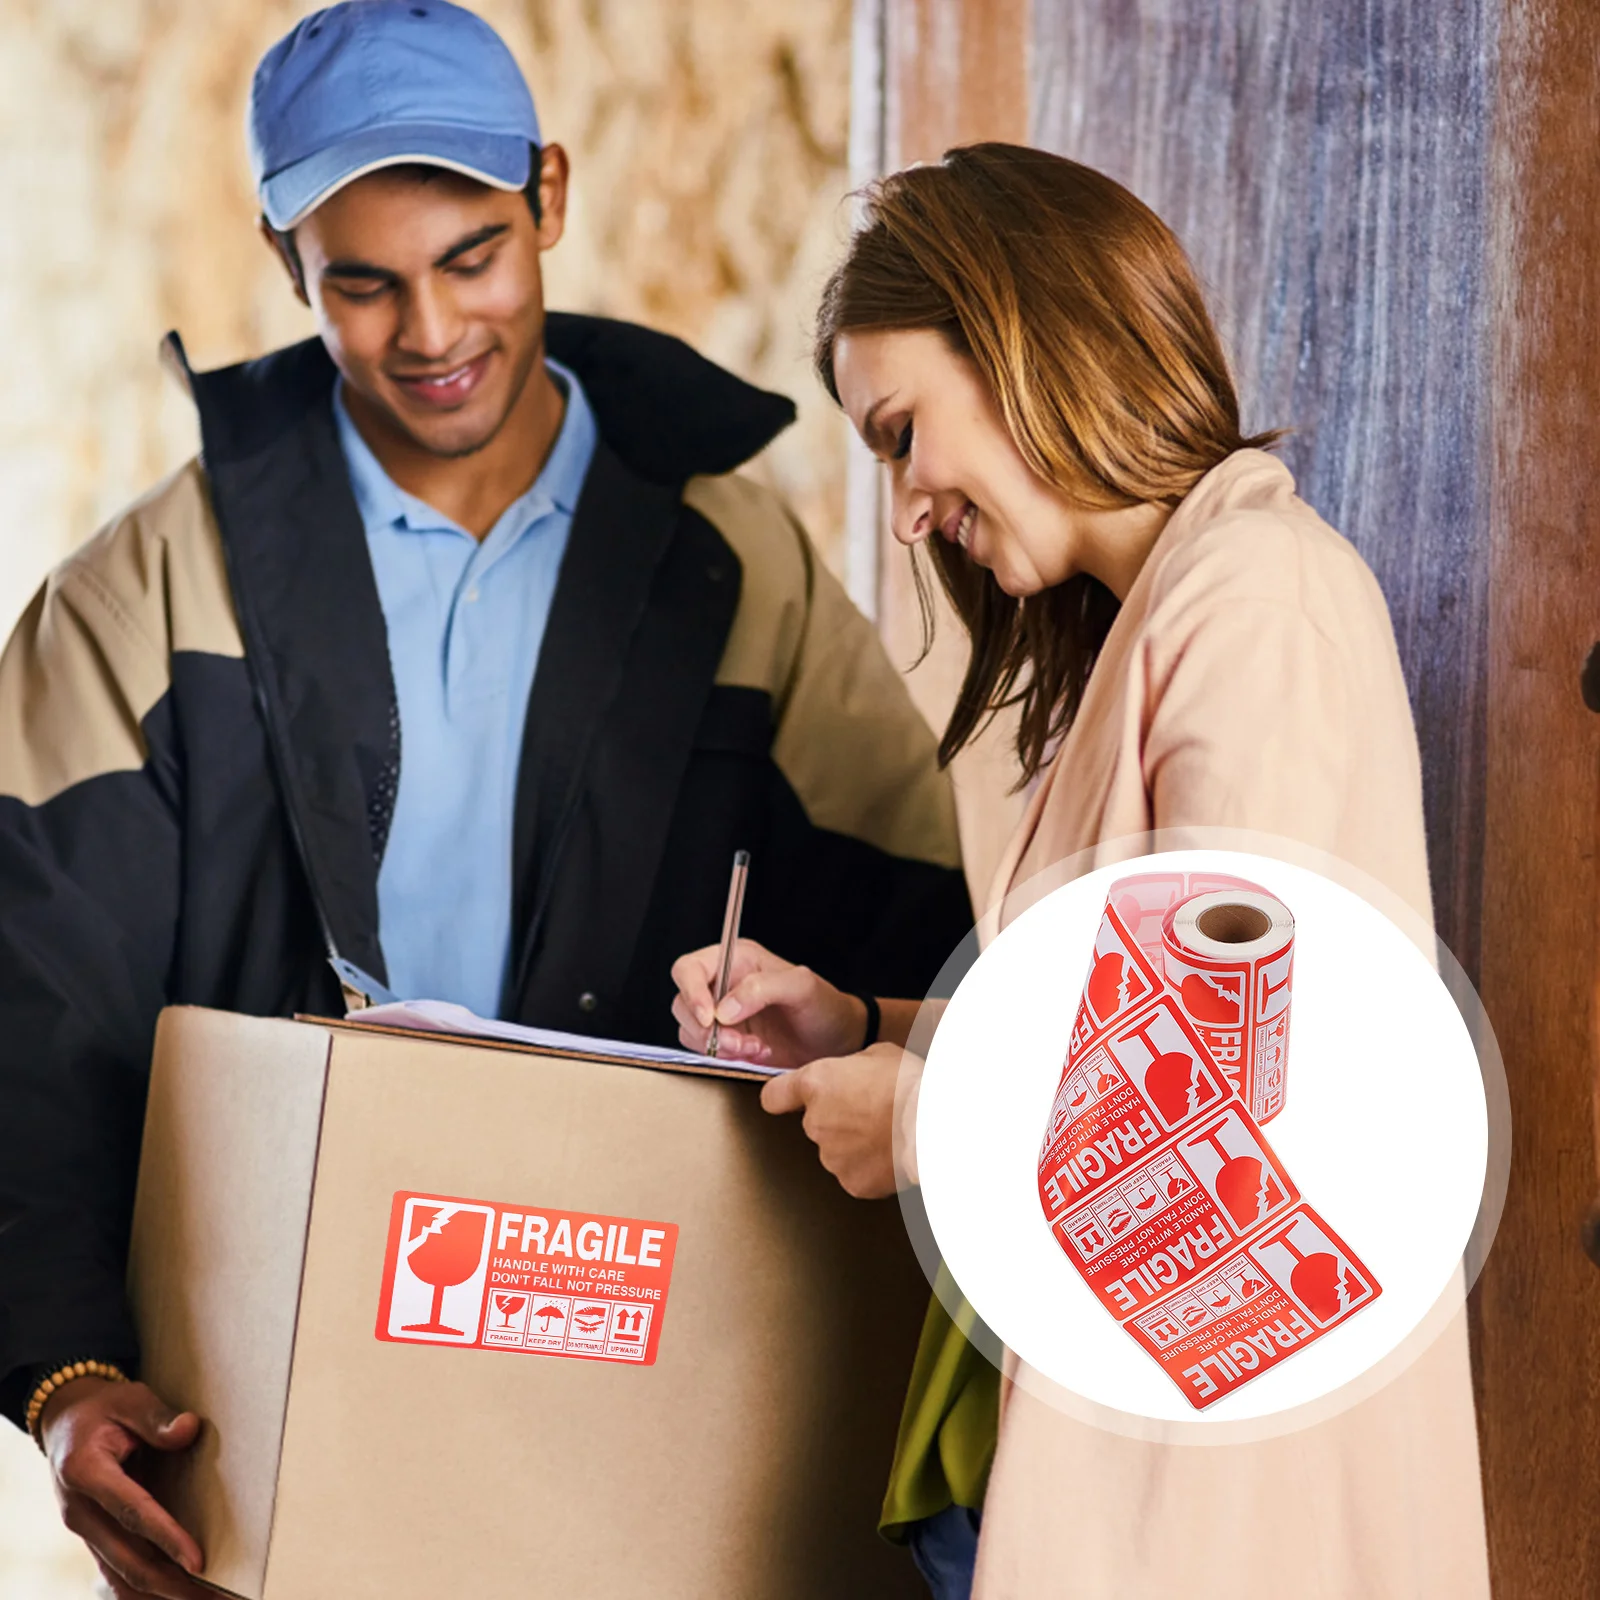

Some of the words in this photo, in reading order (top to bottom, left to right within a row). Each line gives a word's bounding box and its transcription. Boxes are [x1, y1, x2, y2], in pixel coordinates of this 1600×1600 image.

[1084, 1052, 1102, 1069] FRAGILE
[1107, 1087, 1134, 1110] DON'T
[1083, 1107, 1107, 1125] FALL
[1101, 1096, 1141, 1126] HANDLE
[1067, 1123, 1084, 1138] NOT
[1079, 1121, 1103, 1143] WITH
[1043, 1109, 1161, 1211] FRAGILE
[1056, 1141, 1077, 1164] CARE
[1151, 1156, 1172, 1172] FRAGILE
[1122, 1182, 1132, 1191] DRY
[1132, 1174, 1146, 1185] KEEP
[1177, 1191, 1205, 1213] DON'T
[1067, 1212, 1090, 1229] UPWARD
[1154, 1212, 1177, 1229] FALL
[1176, 1201, 1212, 1232] HANDLE
[497, 1212, 666, 1268] FRAGILE
[1135, 1225, 1155, 1243] NOT
[1150, 1229, 1176, 1248] WITH
[1085, 1240, 1135, 1277] PRESSURE
[1104, 1213, 1233, 1312] FRAGILE
[1120, 1244, 1148, 1268] CARE
[493, 1258, 548, 1273] HANDLE
[552, 1264, 586, 1277] WITH
[589, 1267, 625, 1282] CARE
[1223, 1259, 1244, 1276] FRAGILE
[491, 1272, 530, 1286] DON'T
[533, 1276, 563, 1290] FALL
[566, 1280, 592, 1293] NOT
[596, 1284, 662, 1300] PRESSURE
[1196, 1284, 1205, 1294] DRY
[1206, 1277, 1219, 1288] KEEP
[1253, 1290, 1281, 1311] DON'T
[1141, 1310, 1163, 1325] UPWARD
[1230, 1307, 1254, 1326] FALL
[1251, 1299, 1289, 1326] HANDLE
[490, 1334, 519, 1342] FRAGILE
[1211, 1320, 1232, 1338] NOT
[1225, 1319, 1251, 1339] WITH
[610, 1346, 638, 1354] UPWARD
[1160, 1330, 1211, 1362] PRESSURE
[1182, 1309, 1315, 1398] FRAGILE
[1199, 1335, 1225, 1354] CARE
